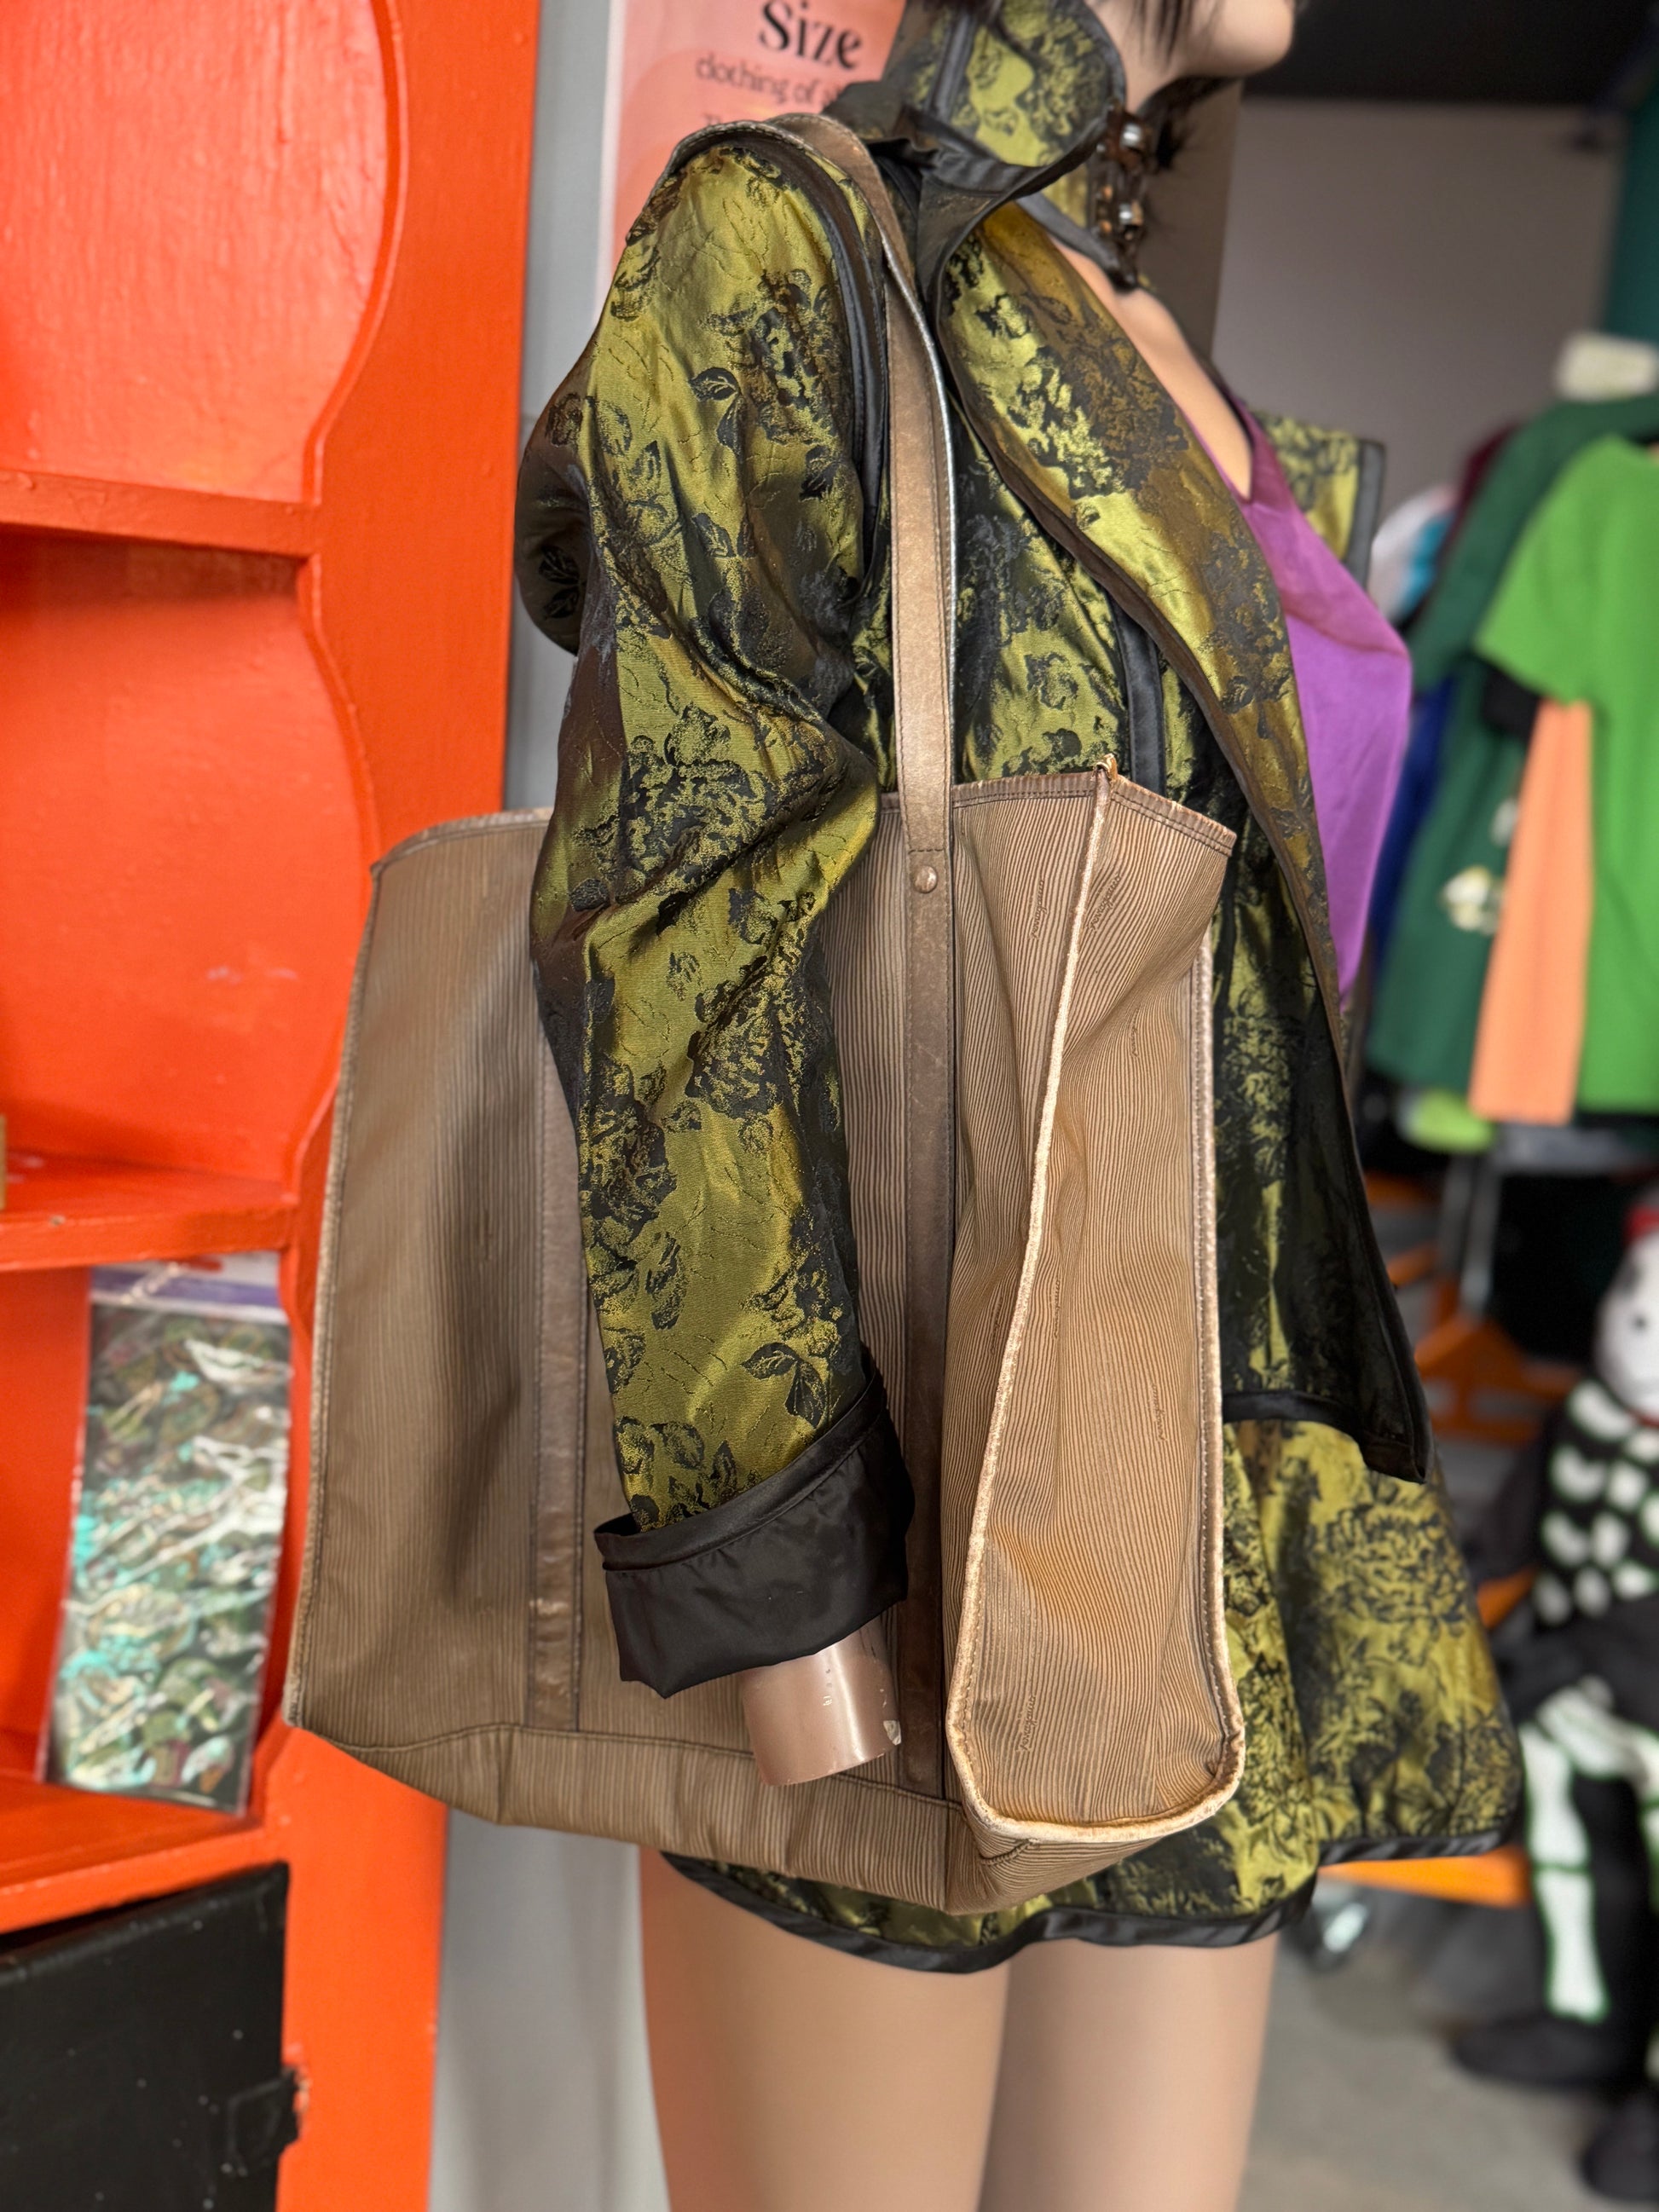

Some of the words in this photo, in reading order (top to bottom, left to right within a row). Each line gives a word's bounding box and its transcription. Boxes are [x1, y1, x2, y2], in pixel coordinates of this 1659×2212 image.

[758, 0, 862, 70] Size
[696, 51, 789, 104] clothing
[793, 78, 819, 105] of
